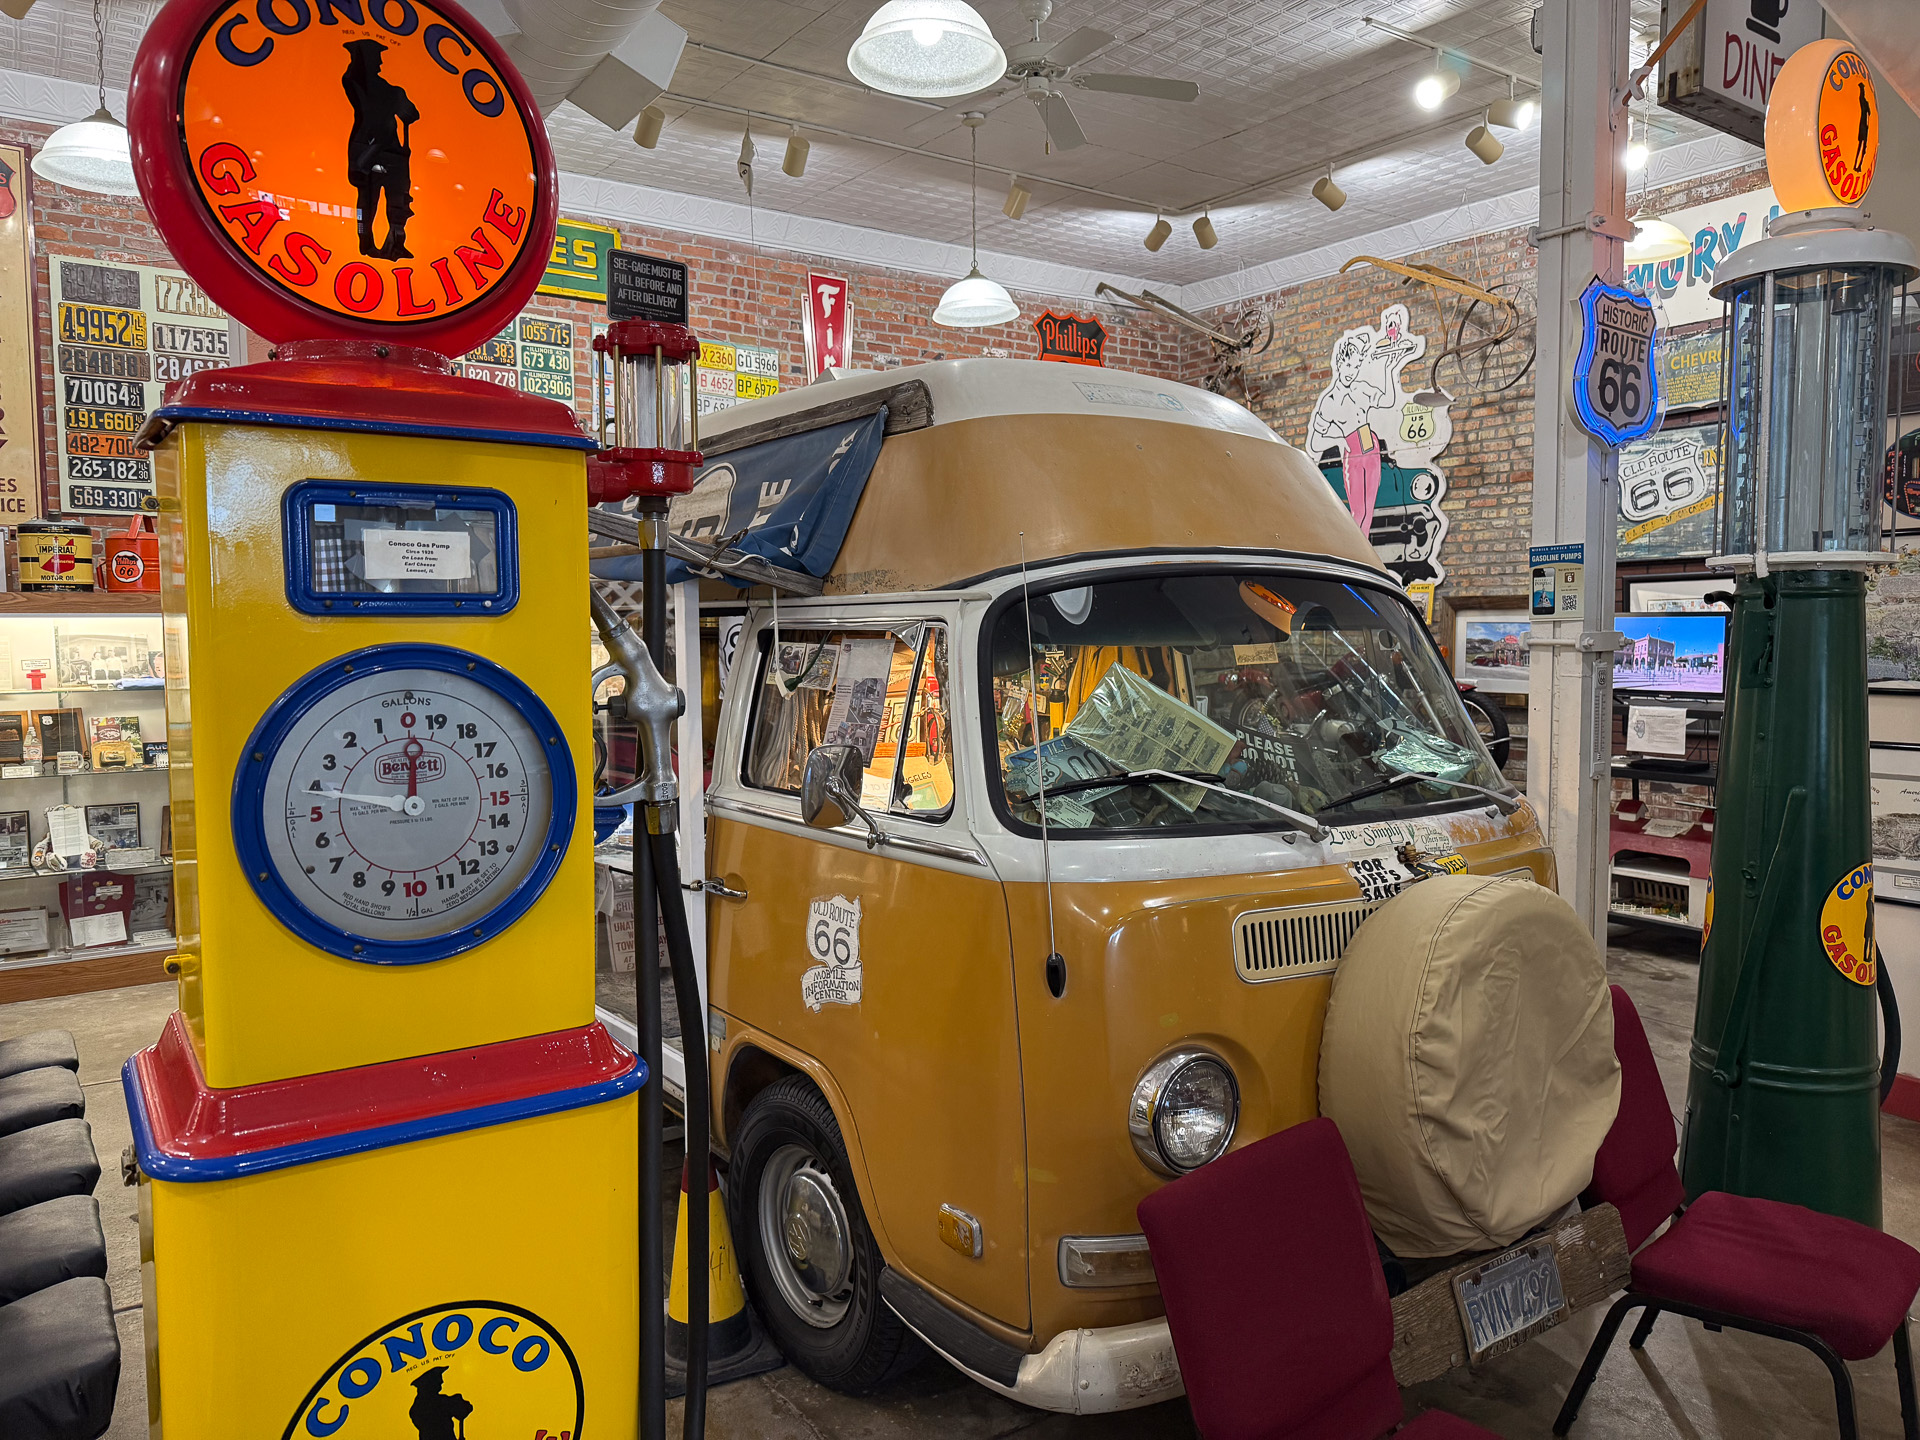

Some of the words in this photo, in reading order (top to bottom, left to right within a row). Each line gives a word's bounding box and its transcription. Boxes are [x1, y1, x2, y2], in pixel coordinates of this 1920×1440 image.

[216, 0, 505, 117] CONOCO
[200, 142, 526, 316] GASOLINE
[651, 265, 672, 279] MUST
[672, 269, 682, 281] BE
[614, 272, 633, 287] FULL
[635, 276, 665, 293] BEFORE
[666, 282, 682, 296] AND
[618, 288, 642, 303] AFTER
[643, 292, 677, 309] DELIVERY
[63, 306, 131, 347] 49952
[1602, 304, 1649, 333] HISTORIC
[156, 326, 228, 355] 117535
[522, 324, 547, 341] 1055
[550, 327, 570, 345] 715
[1043, 319, 1097, 362] Phillips
[493, 342, 515, 359] 383
[1601, 328, 1646, 363] ROUTE
[467, 354, 494, 362] ILLINOIS
[523, 352, 544, 368] 673
[549, 355, 570, 371] 430
[710, 351, 733, 366] 2360
[755, 357, 777, 372] 5966
[468, 369, 490, 383] 820
[495, 372, 516, 387] 278
[711, 376, 734, 391] 4652
[738, 379, 752, 393] BP
[69, 379, 130, 407] 70064
[1599, 358, 1641, 418] 66
[69, 408, 134, 431] 191-660
[1408, 423, 1427, 439] 66
[70, 435, 135, 455] 482-700
[1648, 445, 1691, 467] ROUTE
[72, 458, 138, 480] 265-182
[74, 487, 138, 508] 569-330
[1631, 467, 1694, 513] 66
[39, 545, 74, 554] IMPERIAL
[1532, 554, 1559, 562] GASOLINE
[1561, 552, 1581, 560] PUMPS
[117, 556, 137, 566] Phillips
[119, 566, 135, 576] 66
[382, 697, 431, 708] GALLONS
[374, 718, 383, 734] 1
[400, 712, 416, 728] 0
[425, 713, 447, 730] 19
[457, 723, 478, 739] 18
[343, 731, 357, 749] 2
[1235, 729, 1294, 756] PLEASE
[474, 742, 497, 758] 17
[323, 754, 336, 771] 3
[382, 759, 439, 776] Benett
[487, 762, 509, 778] 16
[309, 780, 323, 795] 4
[490, 791, 510, 806] 15
[310, 806, 323, 822] 5
[489, 813, 510, 829] 14
[315, 832, 330, 848] 6
[478, 840, 499, 856] 13
[329, 857, 344, 874] 7
[459, 859, 479, 875] 12
[1353, 858, 1386, 875] FOR
[353, 872, 366, 888] 8
[436, 873, 454, 890] 11
[441, 893, 459, 904] HANDS
[460, 883, 475, 894] MUST
[481, 869, 490, 878] SET
[1354, 869, 1401, 888] LIFE'S
[381, 880, 395, 897] 9
[403, 880, 427, 897] 10
[446, 899, 459, 908] ZERO
[460, 886, 479, 901] BEFORE
[480, 867, 500, 888] STARTING
[1363, 884, 1401, 902] SAKE
[342, 891, 353, 900] RED
[354, 898, 369, 907] HAND
[371, 903, 391, 911] SHOWS
[343, 899, 359, 910] TOTAL
[361, 906, 385, 916] GALLONS
[830, 903, 855, 929] ROUTE
[815, 919, 850, 965] 66
[814, 970, 846, 981] MOBILE
[805, 980, 859, 999] INFORMATION
[815, 989, 847, 1001] CENTER
[1488, 1250, 1521, 1268] ARIZONA
[1466, 1284, 1514, 1347] RVN
[306, 1314, 550, 1438] CONOCO
[406, 1364, 418, 1373] REG
